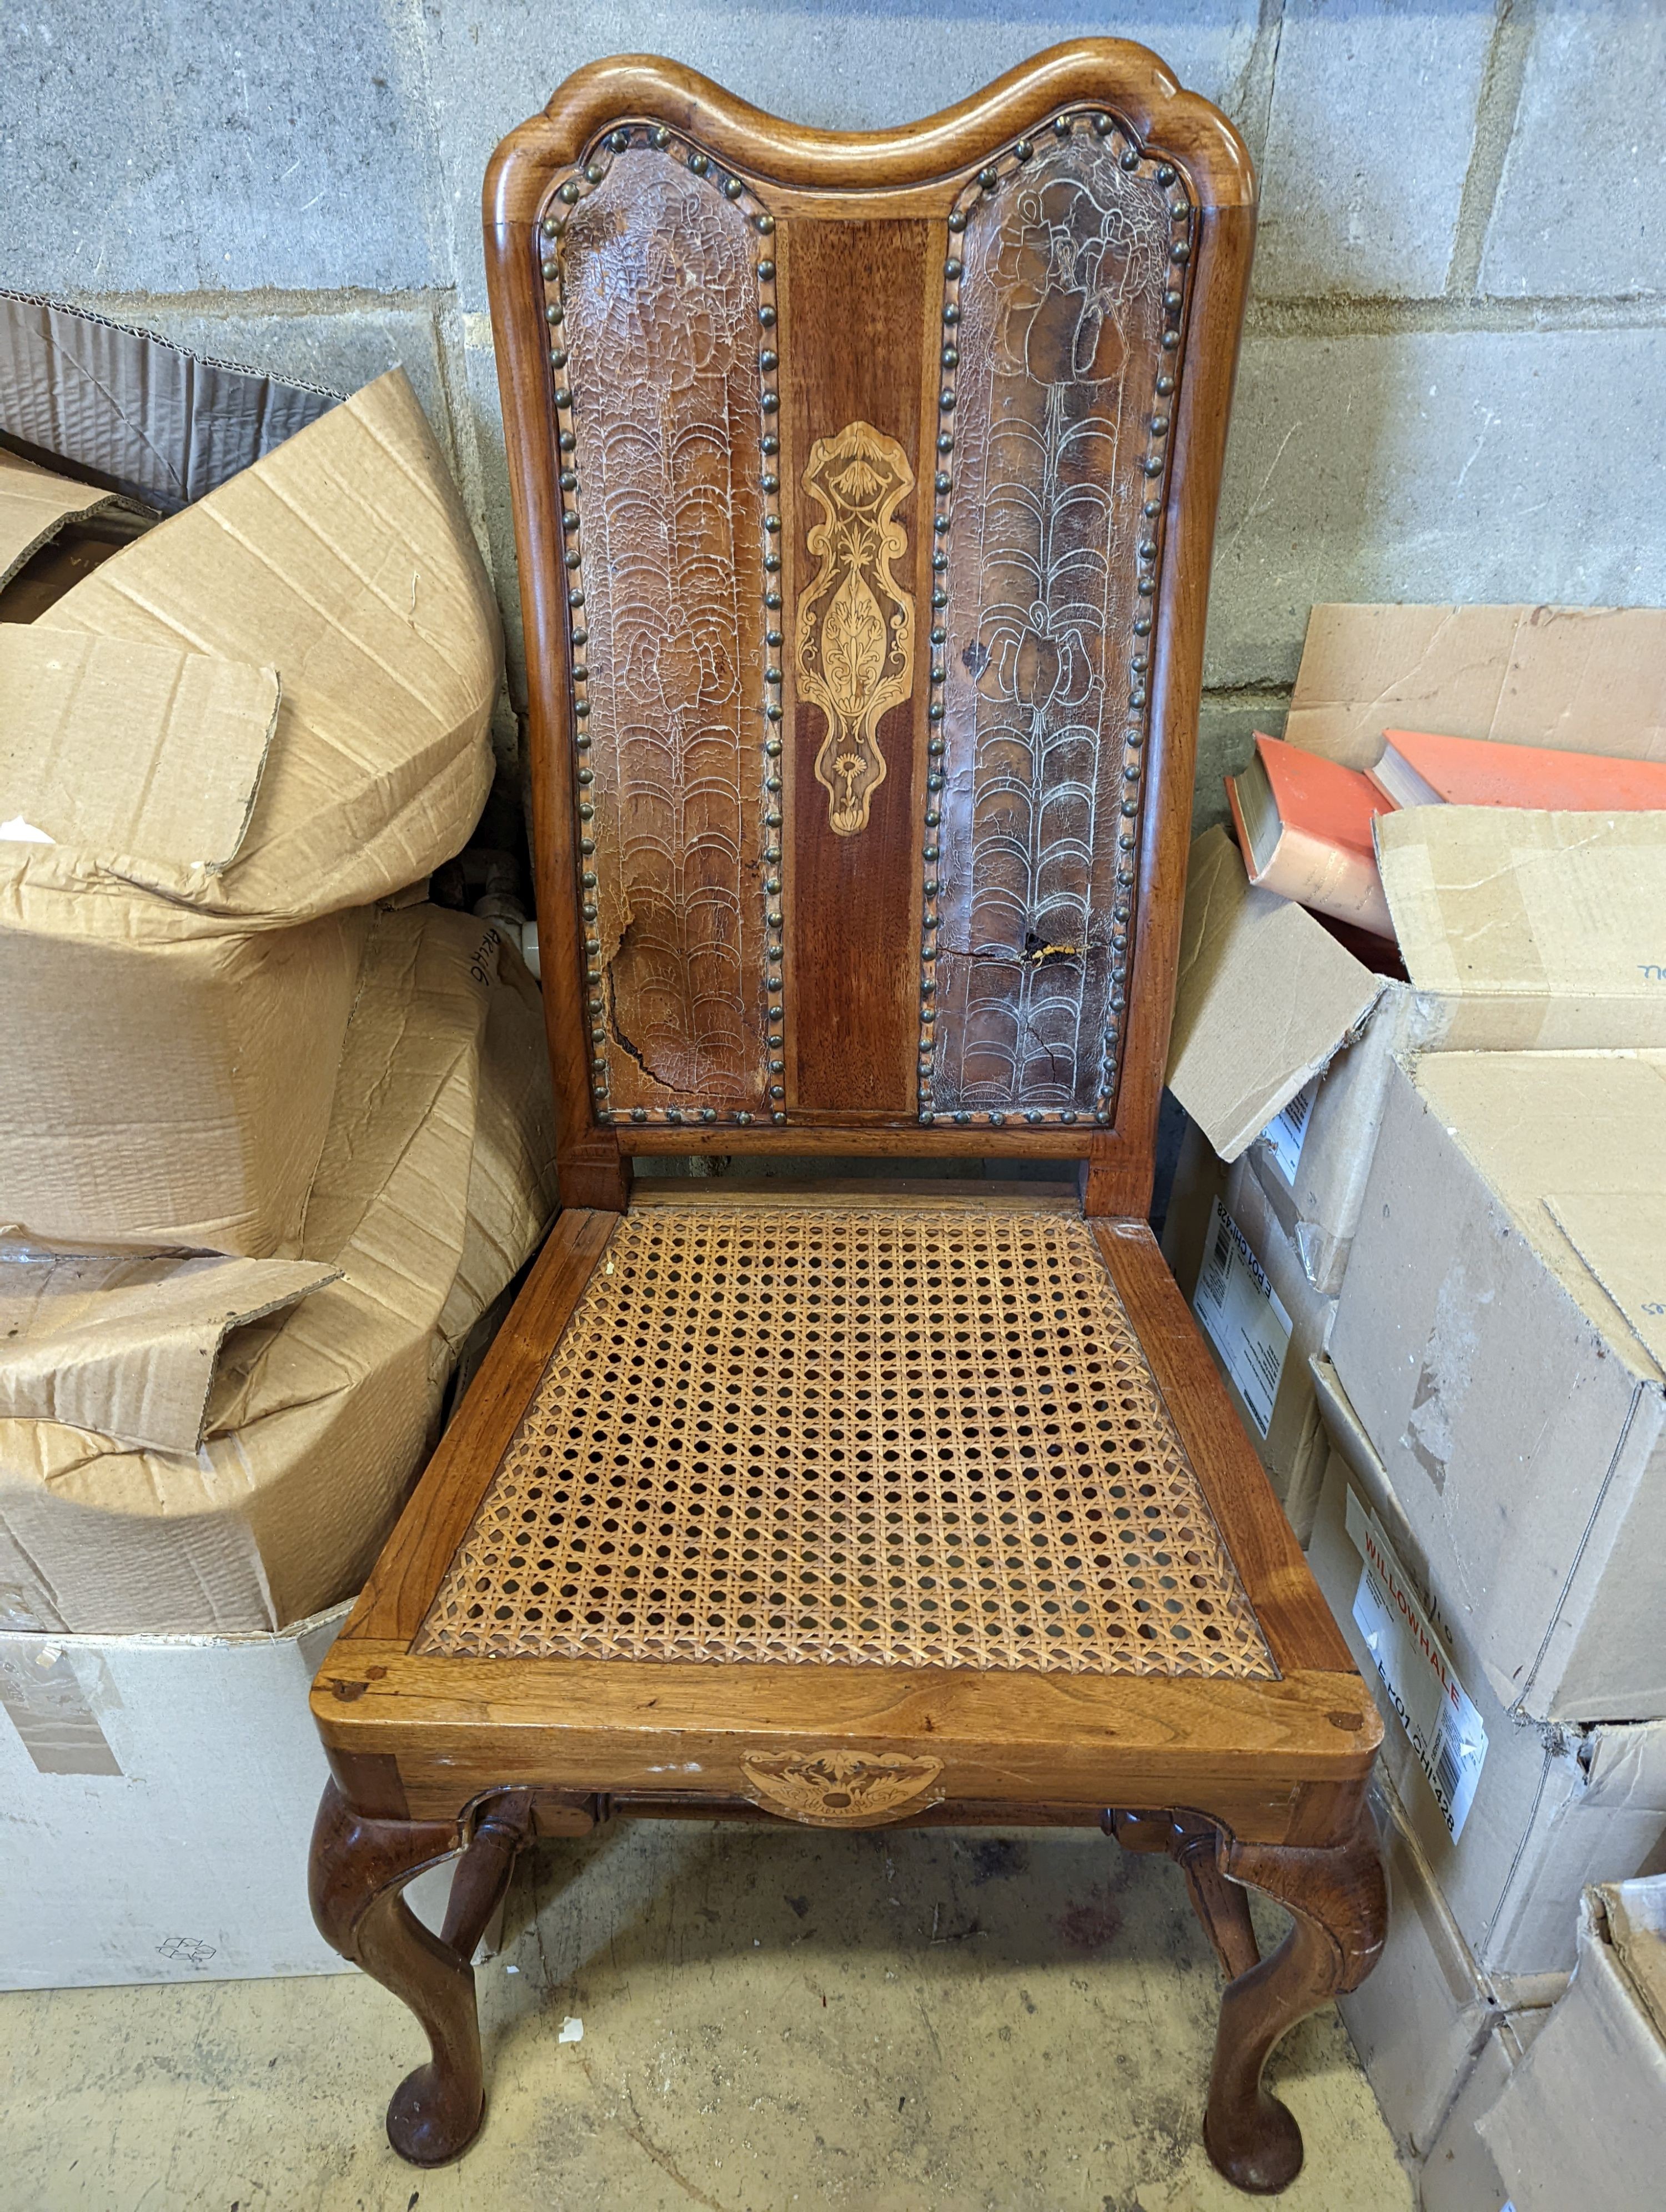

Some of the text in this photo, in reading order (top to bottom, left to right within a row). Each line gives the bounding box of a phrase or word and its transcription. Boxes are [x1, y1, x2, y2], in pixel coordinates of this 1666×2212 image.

[1248, 1253, 1264, 1286] PO1
[1264, 1280, 1271, 1298] E
[1366, 1531, 1461, 1712] WILLOWHALE
